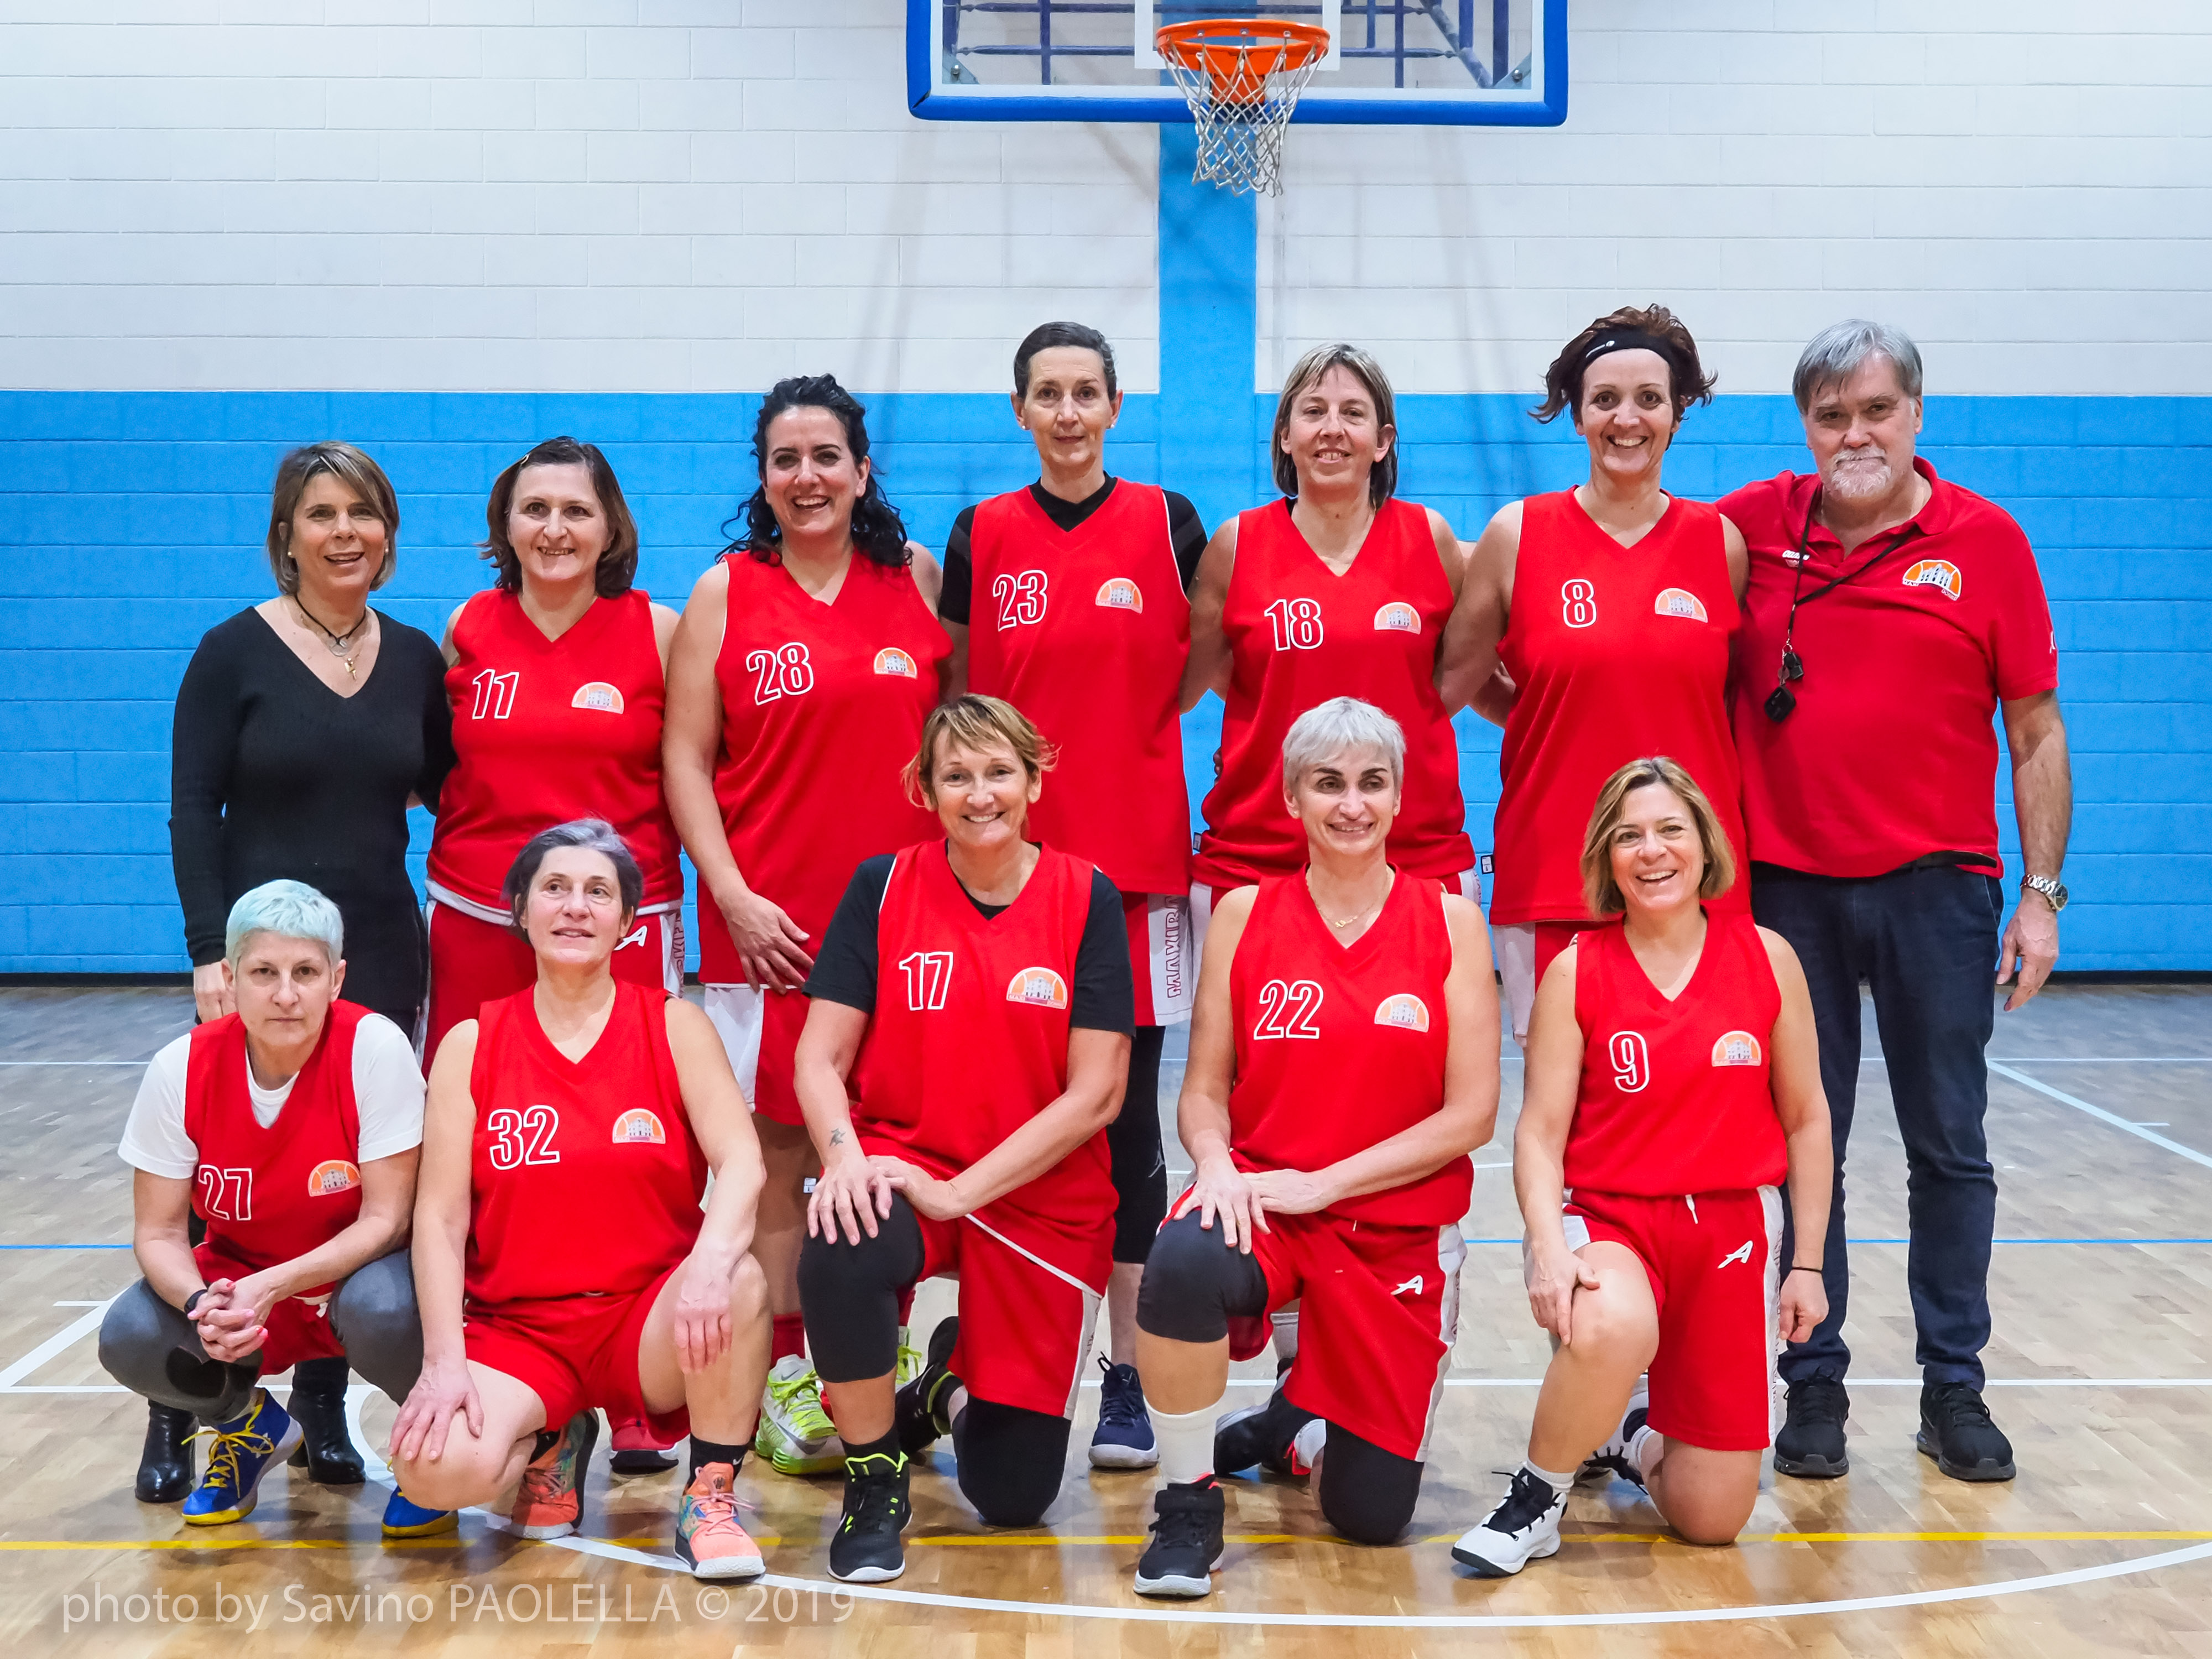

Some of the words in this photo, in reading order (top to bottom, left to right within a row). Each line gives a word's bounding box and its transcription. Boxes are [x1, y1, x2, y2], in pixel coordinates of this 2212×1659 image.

[993, 570, 1047, 632] 23
[1264, 598, 1323, 651] 18
[1562, 579, 1597, 628] 8
[472, 669, 519, 719] 11
[746, 642, 813, 706] 28
[899, 951, 953, 1010] 17
[1254, 979, 1323, 1040] 22
[1609, 1031, 1650, 1092] 9
[488, 1105, 560, 1170] 32
[199, 1165, 252, 1220] 27
